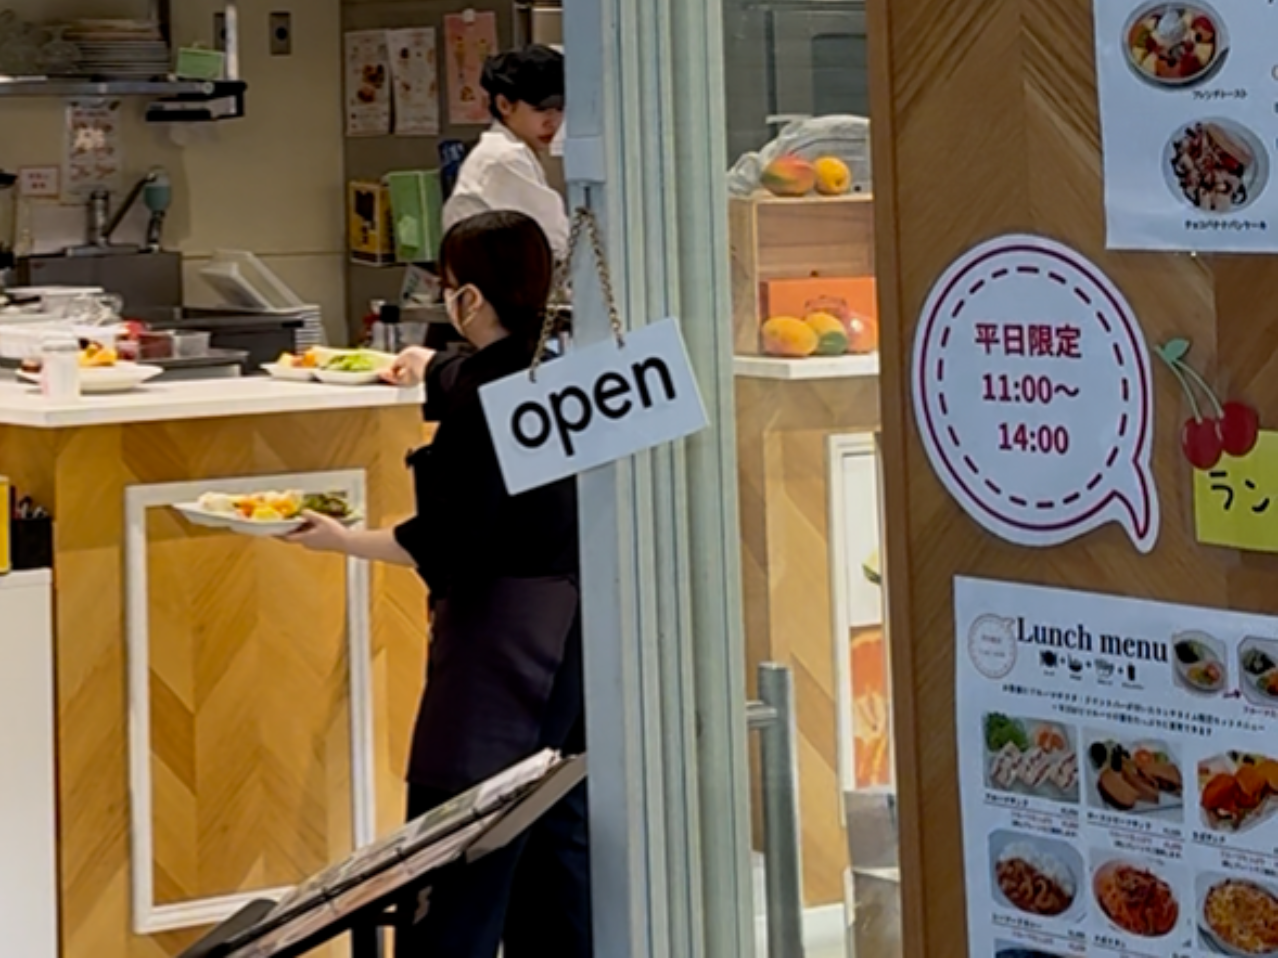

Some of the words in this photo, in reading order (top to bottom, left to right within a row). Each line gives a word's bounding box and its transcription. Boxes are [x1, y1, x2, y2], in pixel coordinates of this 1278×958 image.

[974, 322, 1083, 359] 平日限定
[510, 356, 677, 457] open
[997, 422, 1070, 455] 14:00
[1016, 616, 1093, 652] Lunch
[1099, 630, 1169, 663] menu
